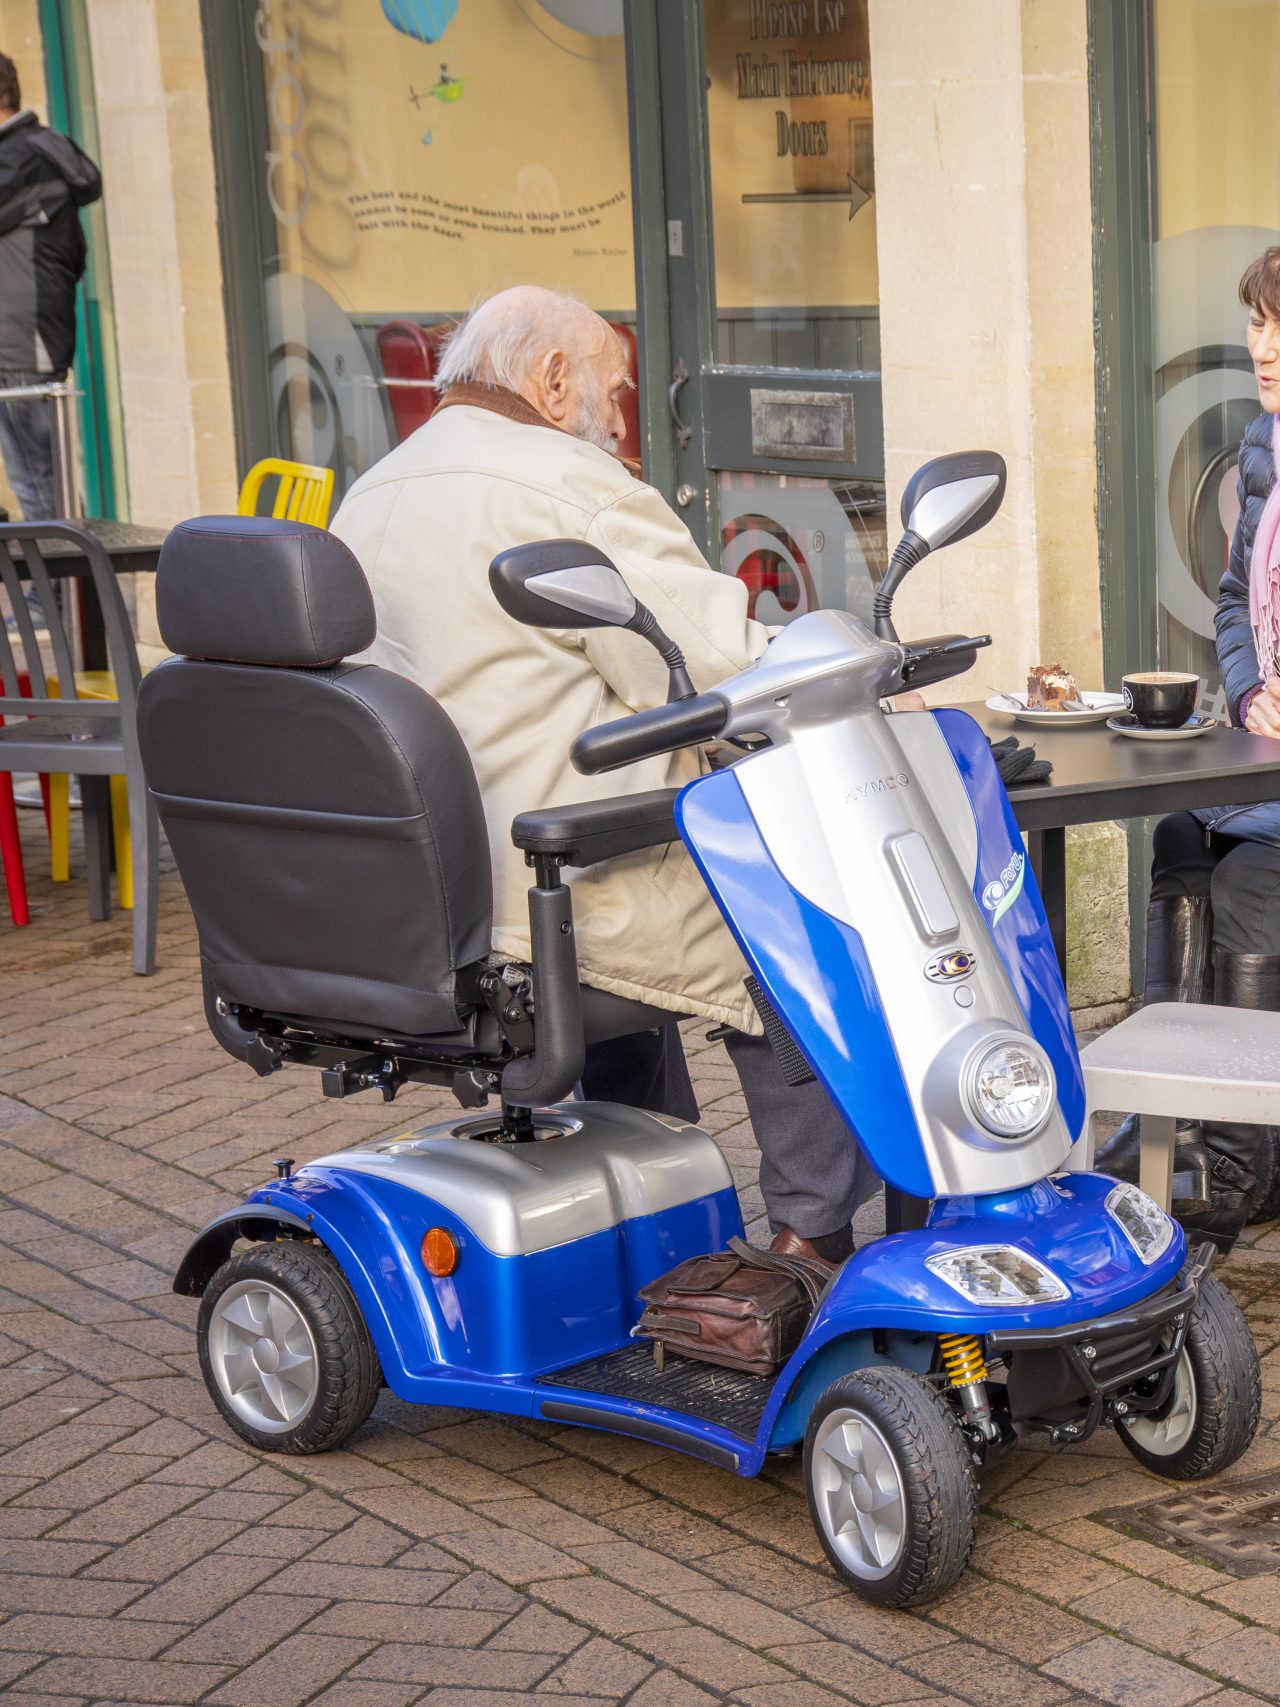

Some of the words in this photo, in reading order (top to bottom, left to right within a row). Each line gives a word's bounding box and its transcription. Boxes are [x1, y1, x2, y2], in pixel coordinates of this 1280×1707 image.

[750, 0, 807, 40] Please
[736, 53, 780, 99] Main
[783, 50, 868, 98] Entrance
[775, 110, 829, 158] Doors
[348, 194, 369, 205] The
[398, 191, 419, 201] and
[422, 192, 440, 205] the
[472, 206, 524, 220] beautiful
[526, 210, 560, 221] things
[563, 209, 576, 218] in
[578, 204, 595, 215] the
[597, 190, 627, 210] world
[394, 204, 408, 213] be
[530, 224, 557, 236] They
[560, 220, 587, 234] must
[588, 217, 601, 226] be
[381, 218, 408, 229] with
[411, 220, 430, 231] the
